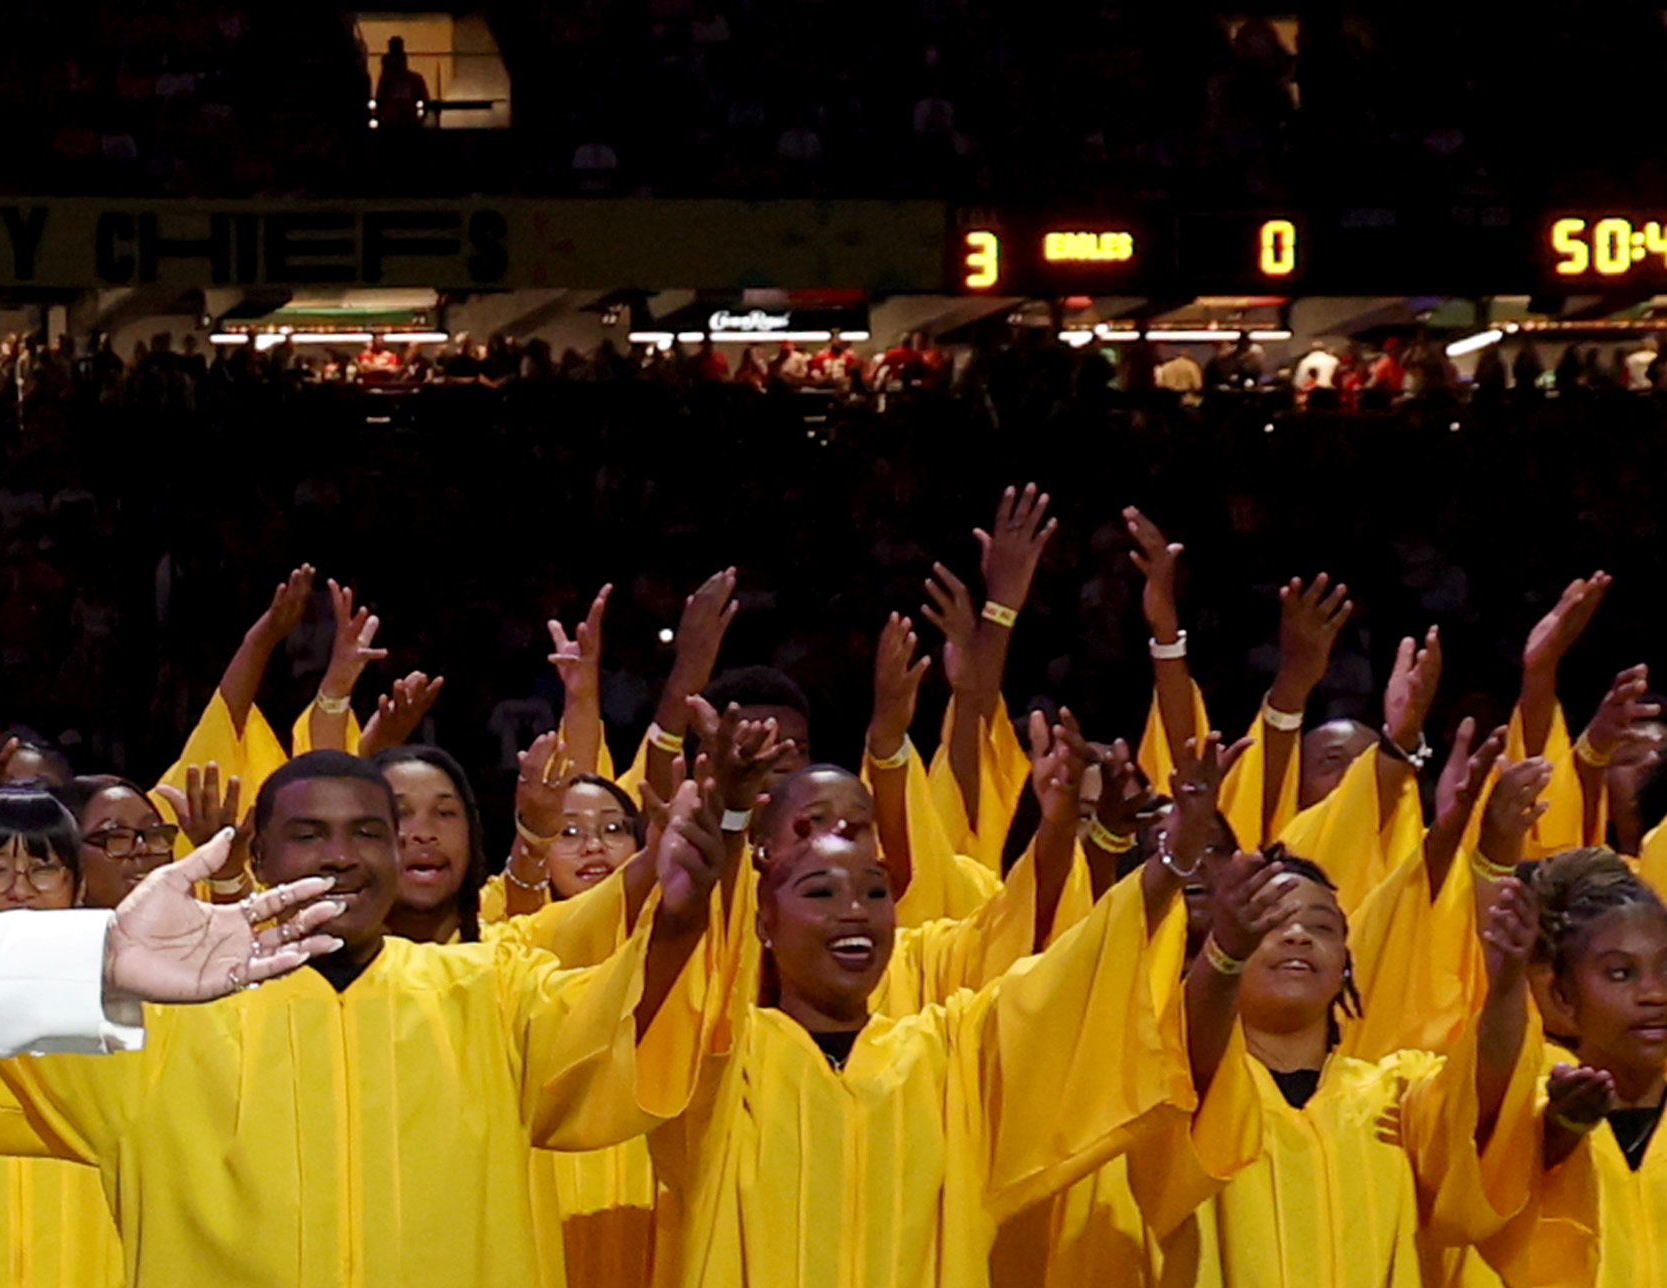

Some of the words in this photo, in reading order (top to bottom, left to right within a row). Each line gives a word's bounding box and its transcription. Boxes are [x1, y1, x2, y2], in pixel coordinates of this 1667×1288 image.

[95, 209, 509, 283] CHIEFS
[964, 230, 999, 290] 3
[1258, 219, 1296, 276] 0
